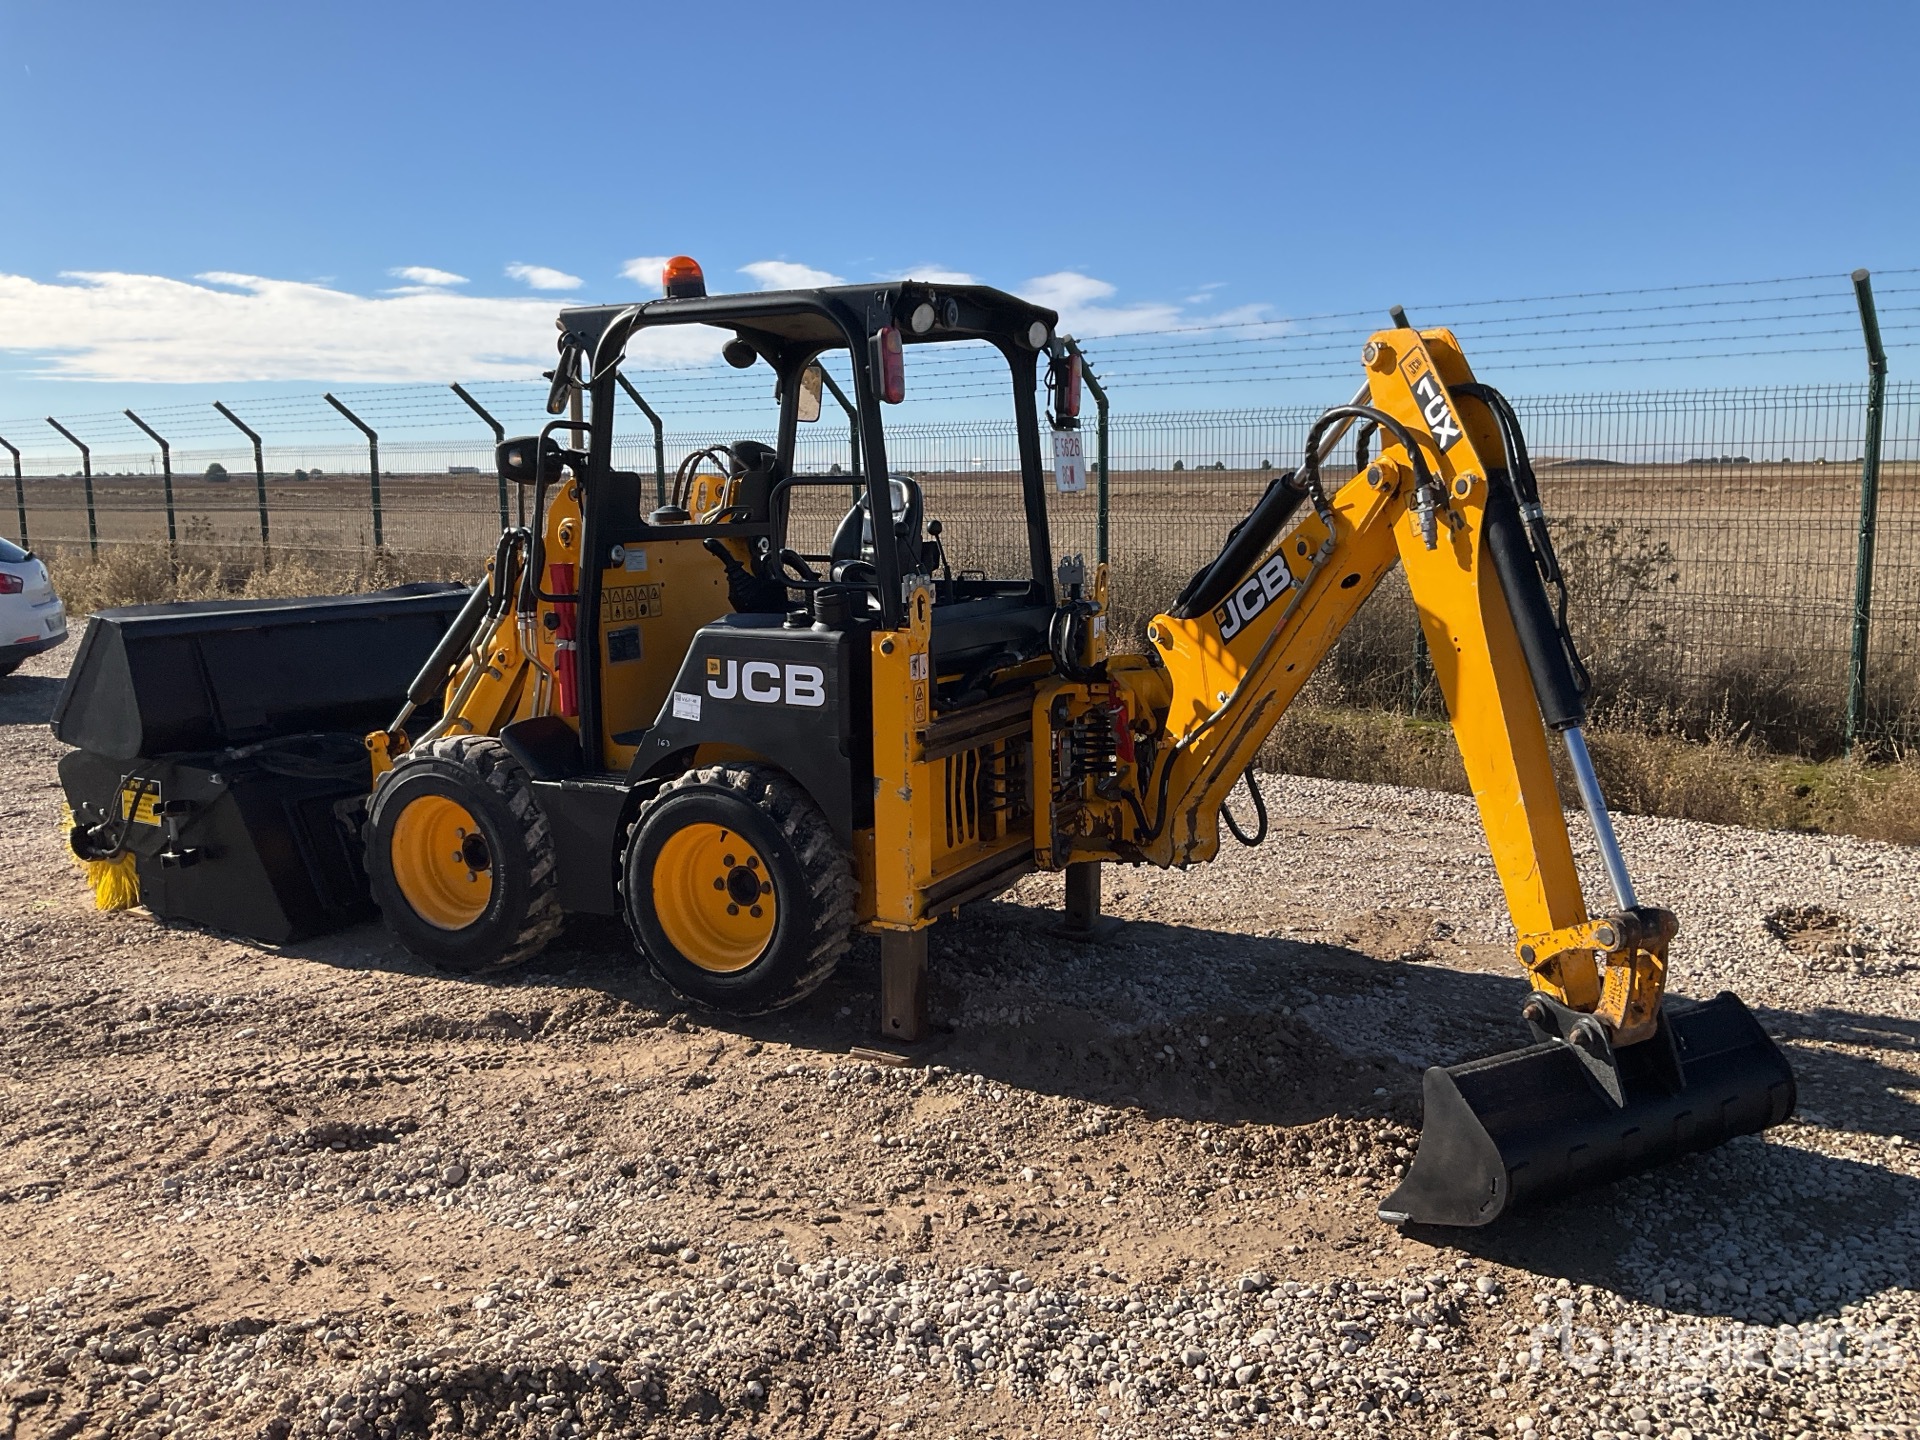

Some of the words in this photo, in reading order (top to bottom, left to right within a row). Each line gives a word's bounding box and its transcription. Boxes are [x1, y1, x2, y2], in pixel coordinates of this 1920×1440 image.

[1416, 376, 1461, 449] 1CX
[1054, 437, 1060, 457] E
[1221, 555, 1291, 639] JCB
[707, 659, 826, 707] JCB
